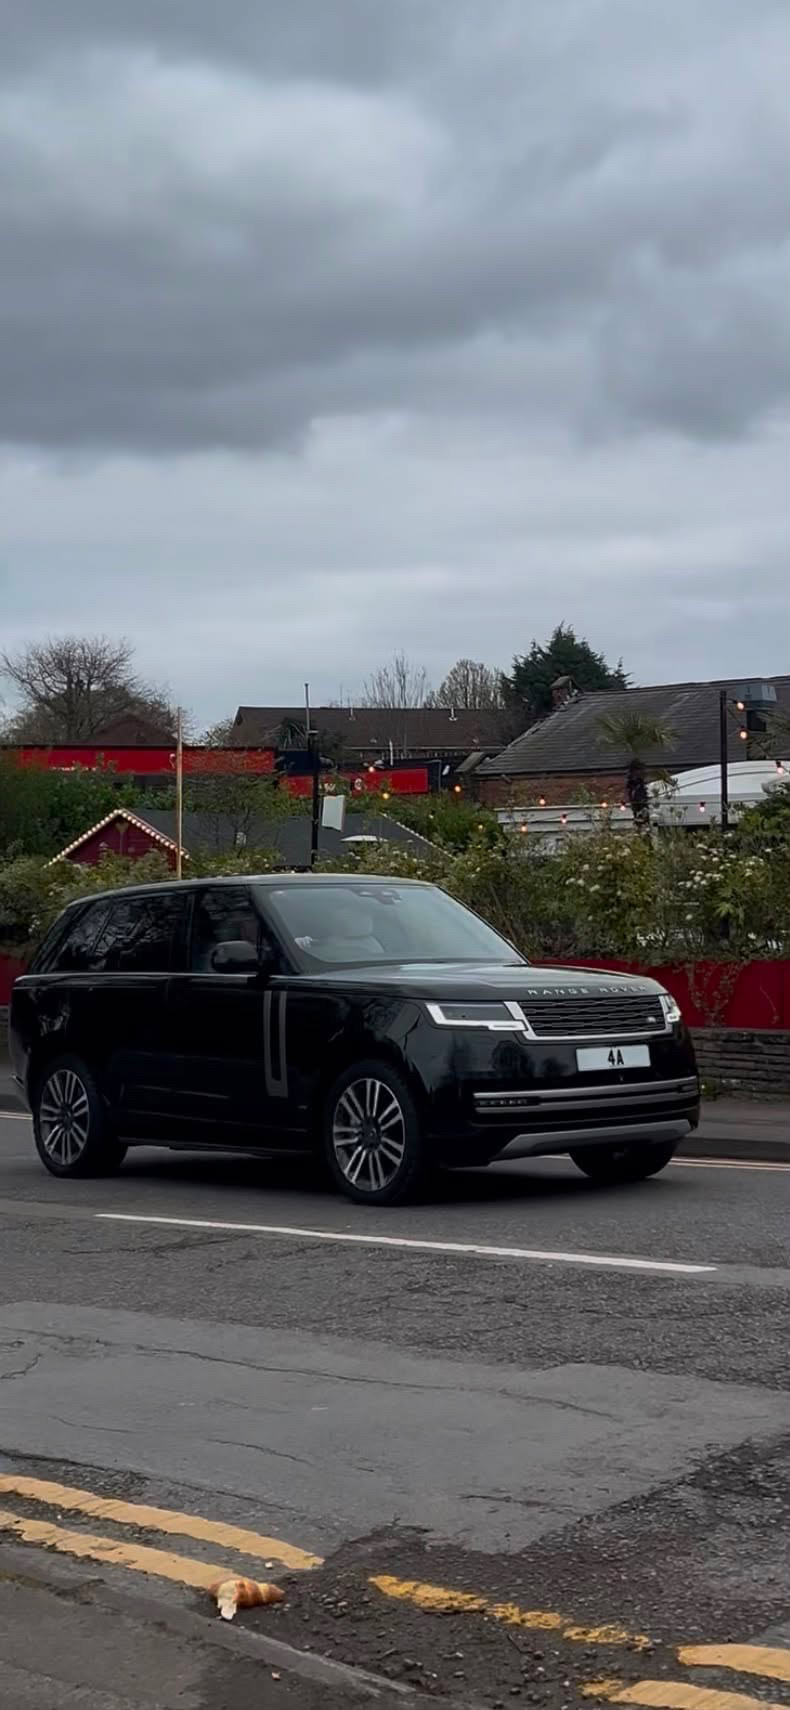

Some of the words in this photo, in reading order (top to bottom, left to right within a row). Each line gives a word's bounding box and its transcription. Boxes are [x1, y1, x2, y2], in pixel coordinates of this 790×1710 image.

[527, 987, 591, 996] RANGE
[599, 985, 647, 993] ROVER
[608, 1049, 624, 1066] 4A
